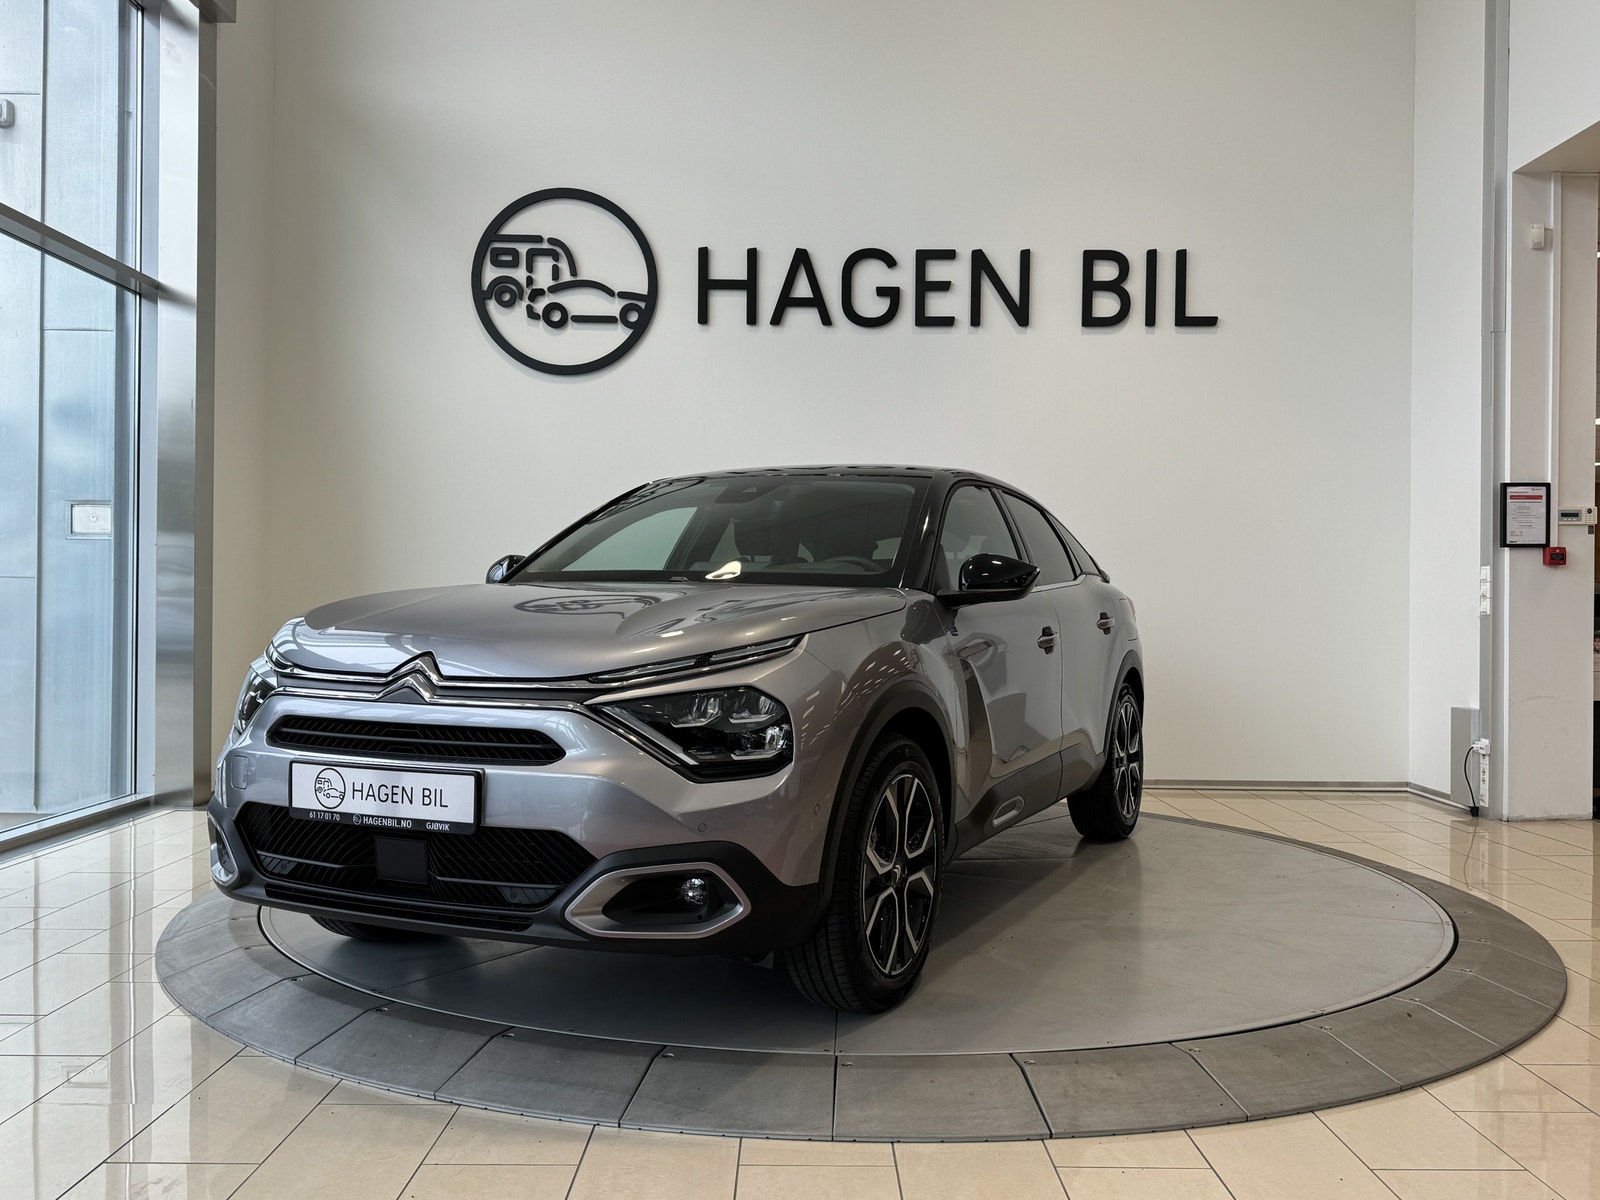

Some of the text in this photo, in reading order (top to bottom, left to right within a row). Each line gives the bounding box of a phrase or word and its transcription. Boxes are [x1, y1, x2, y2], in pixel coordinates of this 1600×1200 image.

[697, 246, 1219, 328] HAGEN BIL
[352, 782, 448, 808] HAGEN BIL
[309, 811, 316, 819] 61
[325, 812, 331, 820] 01
[332, 813, 340, 821] 70
[363, 818, 412, 828] HAGENBIL.NO
[426, 822, 450, 831] GJØVIK
